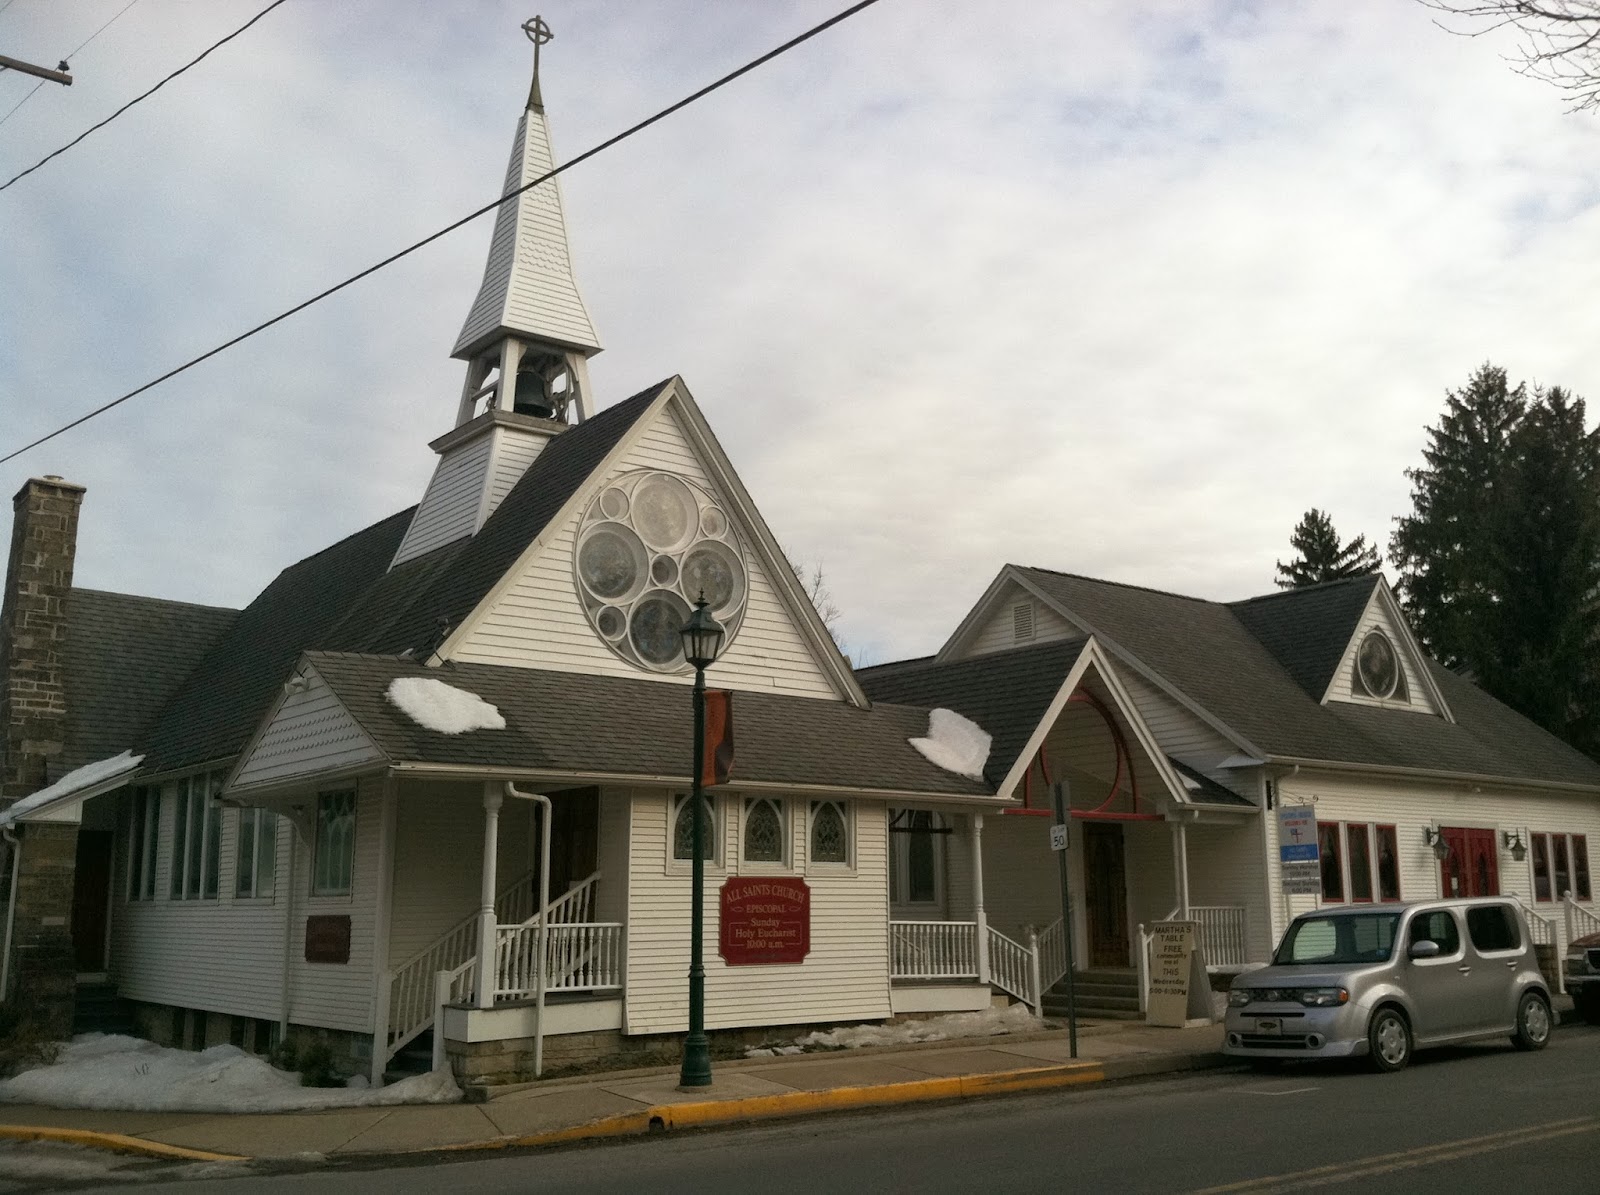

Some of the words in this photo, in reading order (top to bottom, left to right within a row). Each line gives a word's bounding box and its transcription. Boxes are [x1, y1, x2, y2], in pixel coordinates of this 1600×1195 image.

[1054, 835, 1064, 847] 50
[726, 889, 742, 904] ALL
[743, 884, 771, 898] SAINTS
[772, 885, 805, 904] CHURCH
[747, 904, 787, 914] EPISCOPAL
[750, 918, 781, 928] Sunday
[735, 928, 756, 940] Holy
[757, 928, 797, 938] Eucharist
[1160, 934, 1184, 942] TABLE
[746, 939, 767, 949] 10:00
[1163, 945, 1182, 953] FREE
[1163, 967, 1179, 976] THIS
[1152, 977, 1185, 985] Wednesday
